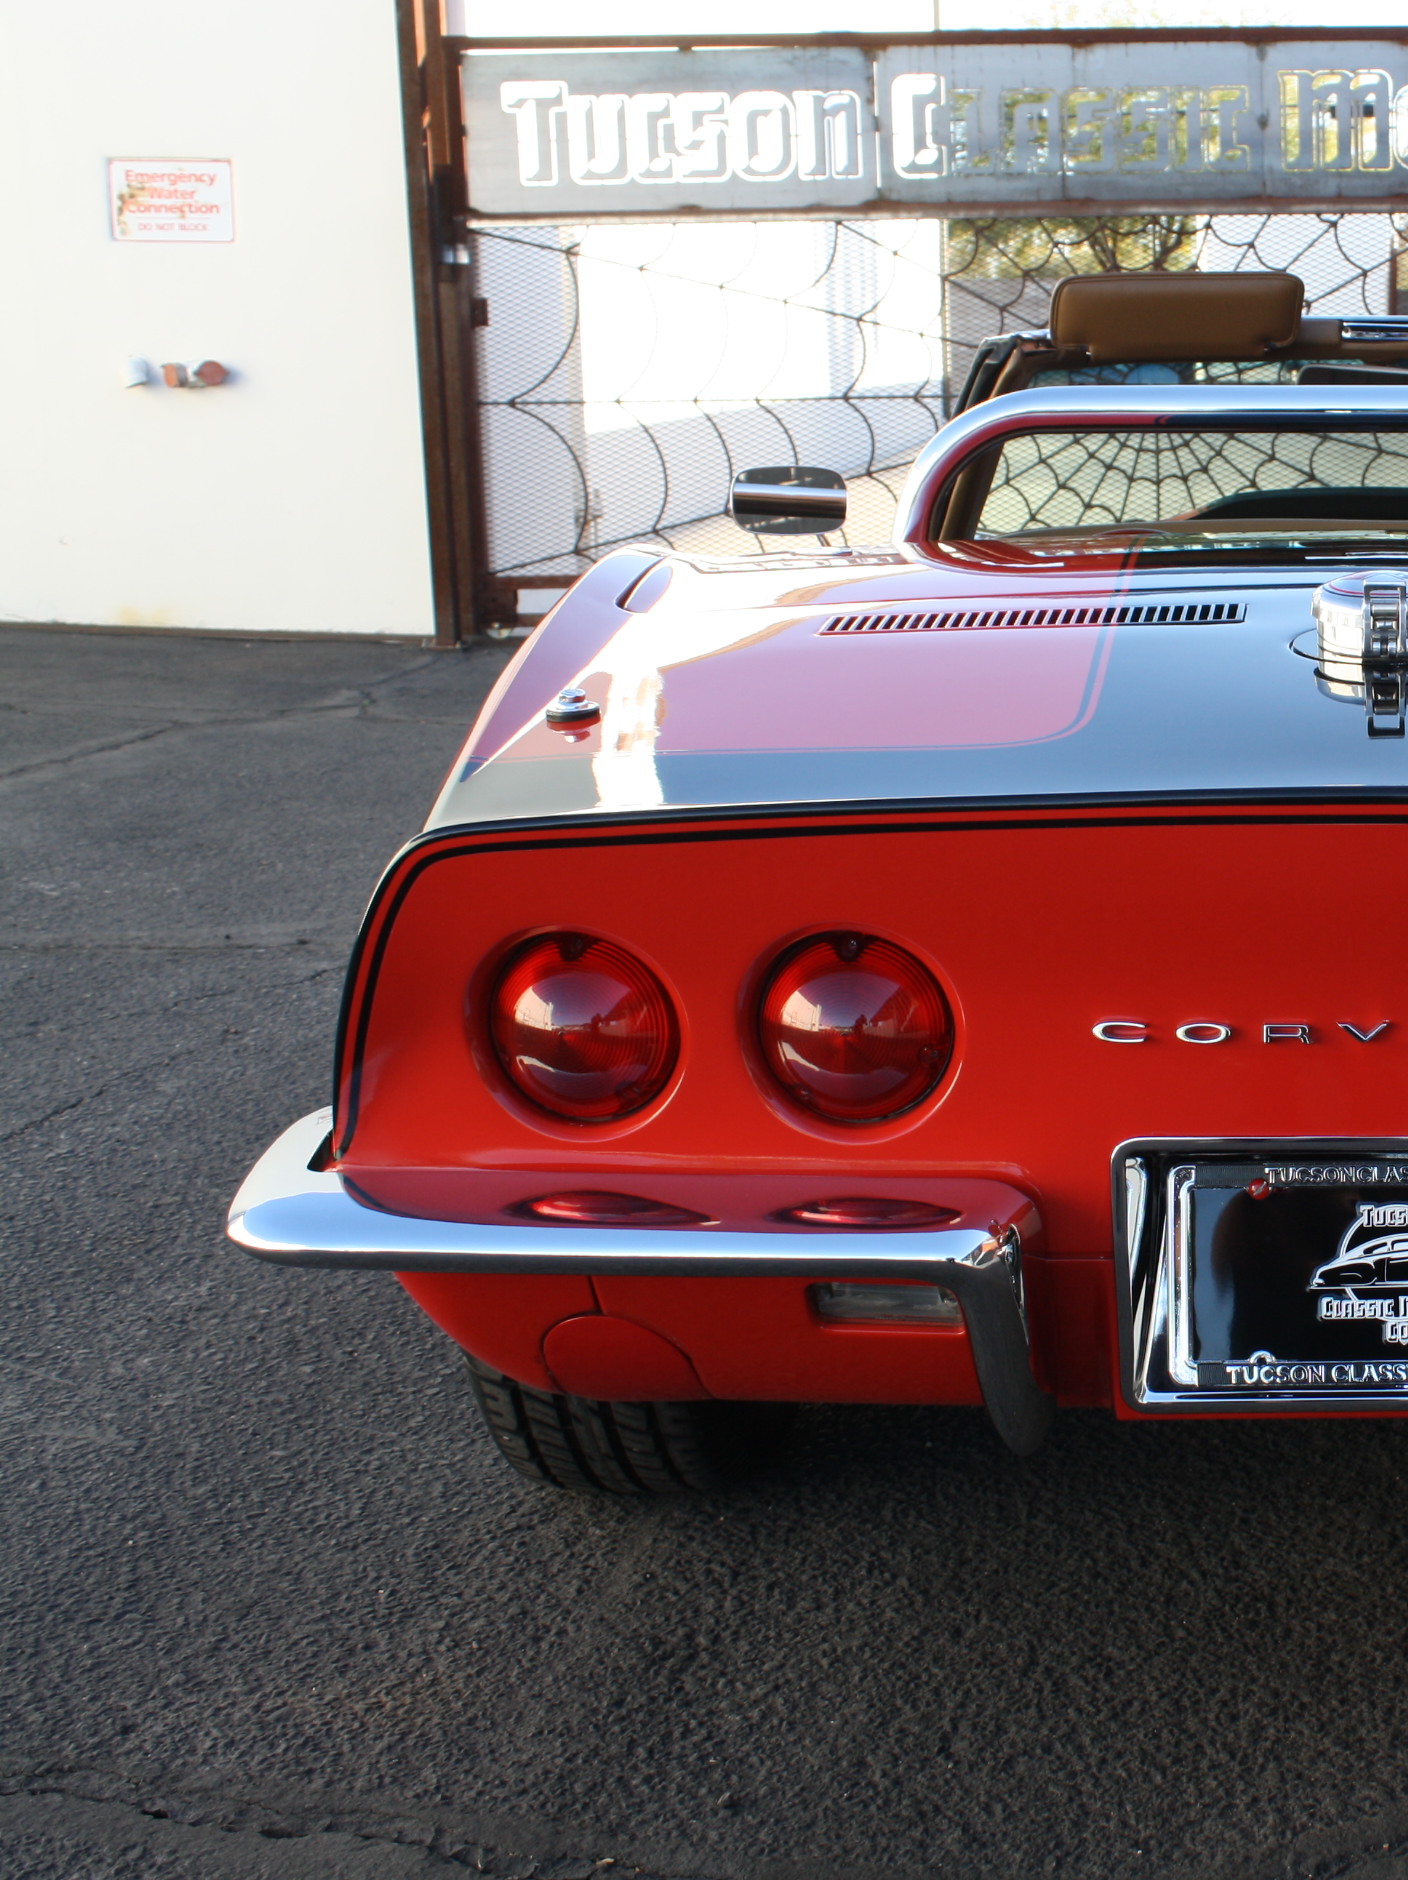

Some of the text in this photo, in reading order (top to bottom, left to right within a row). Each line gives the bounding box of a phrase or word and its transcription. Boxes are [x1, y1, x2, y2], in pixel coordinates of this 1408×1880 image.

[125, 169, 217, 185] Emergency
[148, 187, 197, 199] Water
[127, 202, 220, 214] Connection
[138, 223, 209, 231] DO NOT BLOCK
[1225, 1364, 1325, 1384] TUCSON
